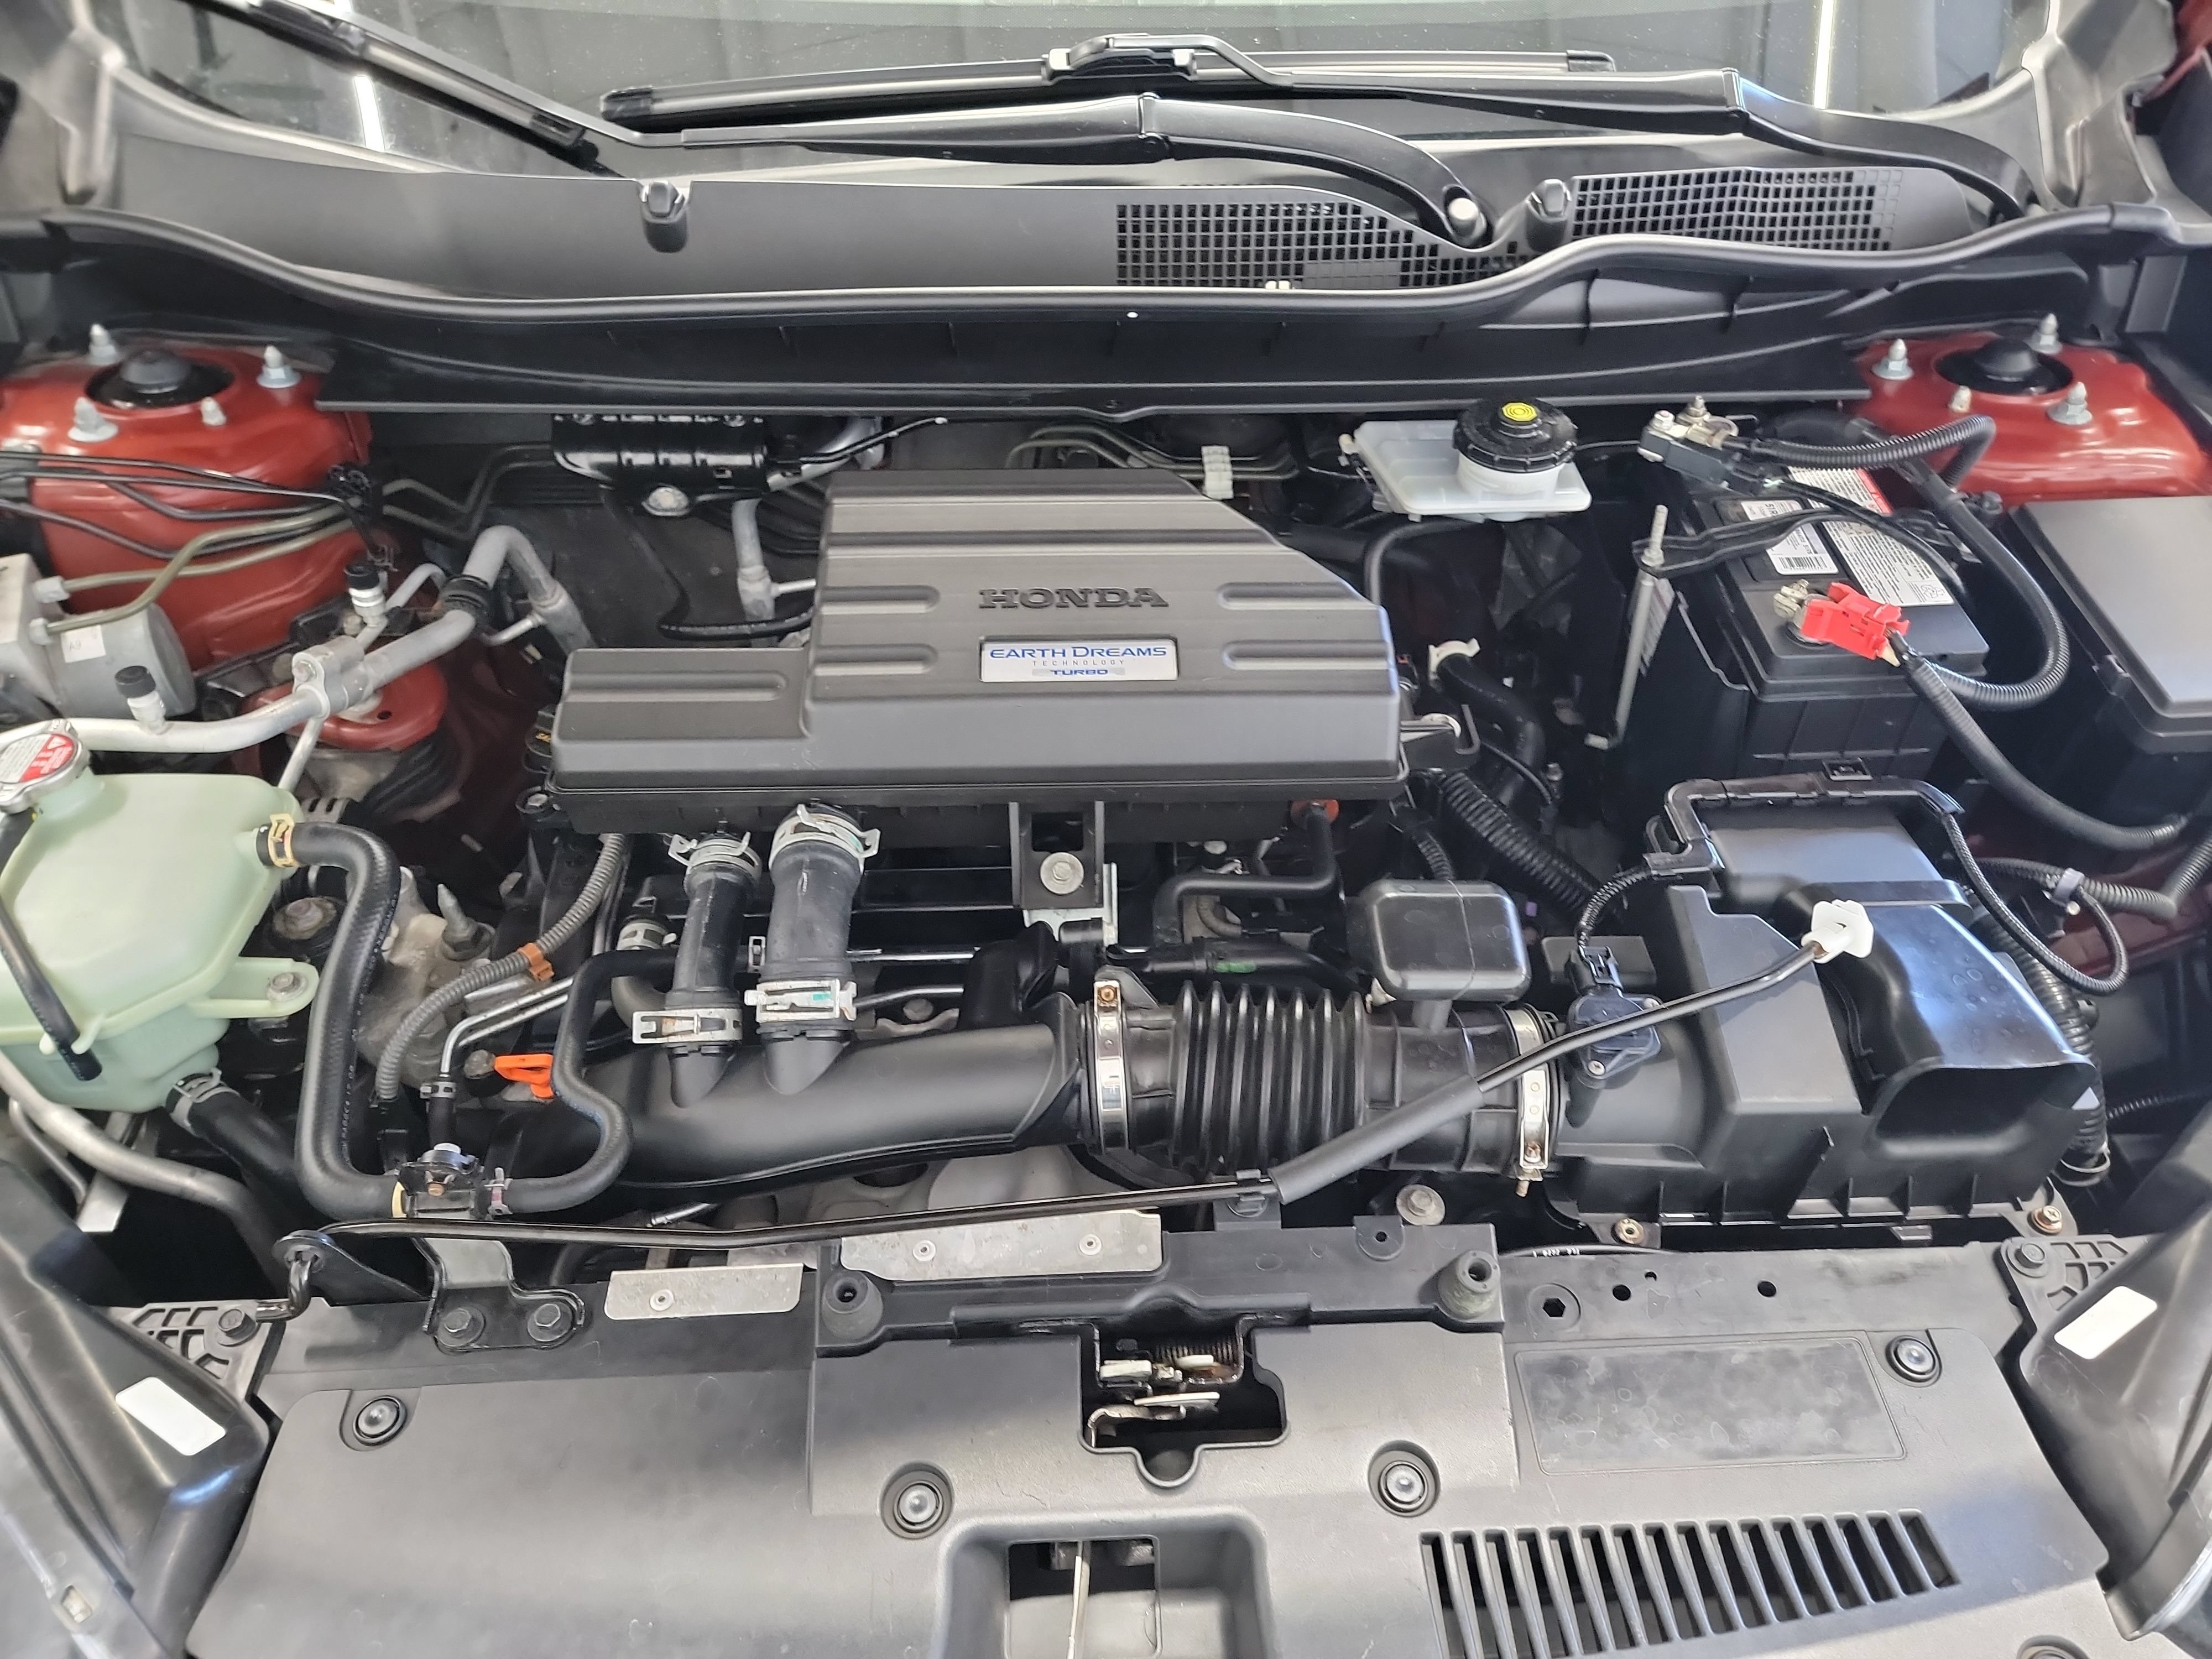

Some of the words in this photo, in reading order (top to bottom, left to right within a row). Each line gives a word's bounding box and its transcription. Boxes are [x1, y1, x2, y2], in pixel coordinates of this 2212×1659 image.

[978, 587, 1169, 609] HONDA
[989, 648, 1066, 659] EARTH
[1072, 646, 1167, 658] DREAMS
